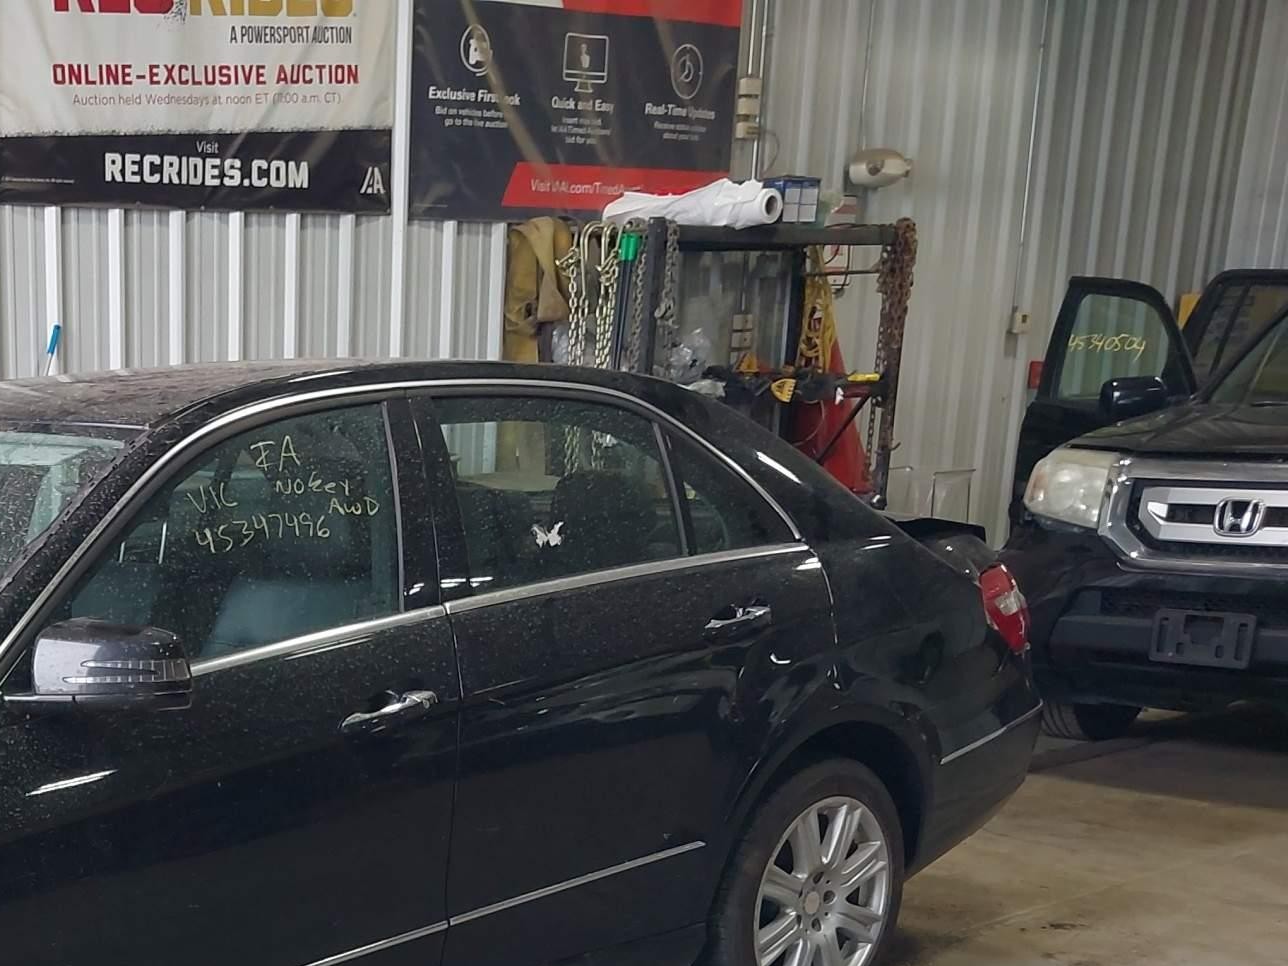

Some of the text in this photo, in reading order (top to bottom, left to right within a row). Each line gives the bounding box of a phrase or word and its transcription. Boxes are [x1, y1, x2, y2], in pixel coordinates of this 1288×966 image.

[230, 26, 352, 44] A POWERSPORT AUCTION
[52, 64, 359, 85] ONLINE-EXCLUSIVE AUCTION
[73, 94, 116, 105] Auction
[118, 94, 142, 105] held
[145, 94, 210, 107] Wednesdays
[212, 95, 223, 105] at
[225, 95, 252, 105] noon
[255, 93, 269, 104] ET
[324, 92, 342, 104] CT)
[428, 86, 476, 101] Exclusive
[551, 96, 615, 114] Quick and Easy
[644, 103, 688, 117] Real-Time
[196, 141, 219, 153] Visit
[104, 152, 309, 188] RECRIDES.COM
[530, 179, 551, 192] Visit
[194, 512, 331, 554] 45347496
